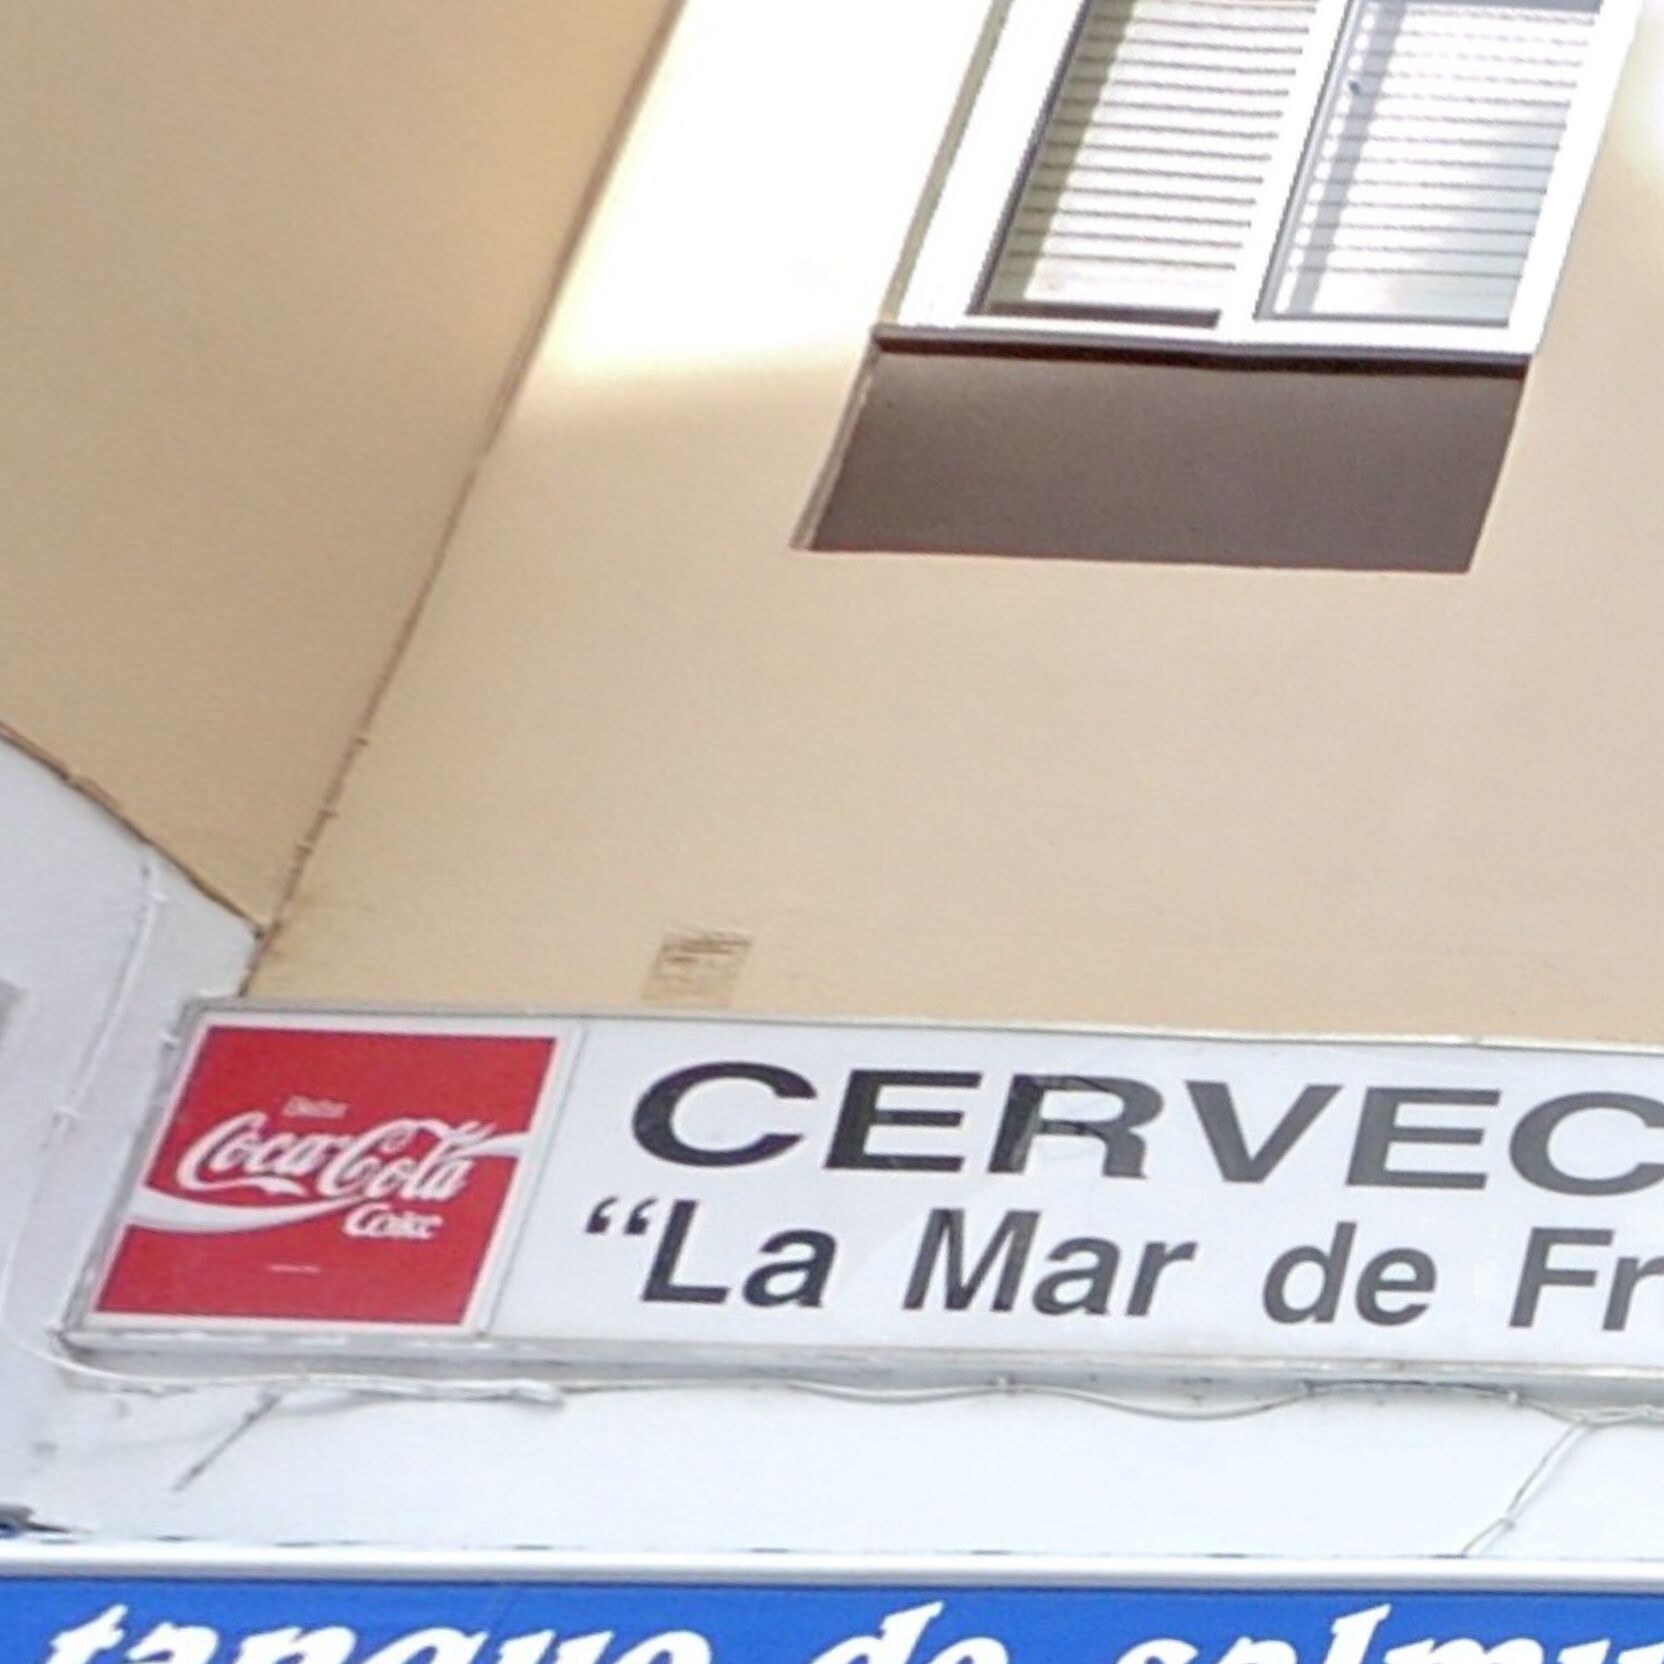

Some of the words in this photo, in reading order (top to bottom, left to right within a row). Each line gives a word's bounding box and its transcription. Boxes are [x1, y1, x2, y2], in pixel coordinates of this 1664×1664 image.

[176, 1110, 490, 1202] Coca-Cola
[343, 1203, 443, 1239] Coke
[902, 1208, 1196, 1320] Mar
[1260, 1220, 1440, 1332] de
